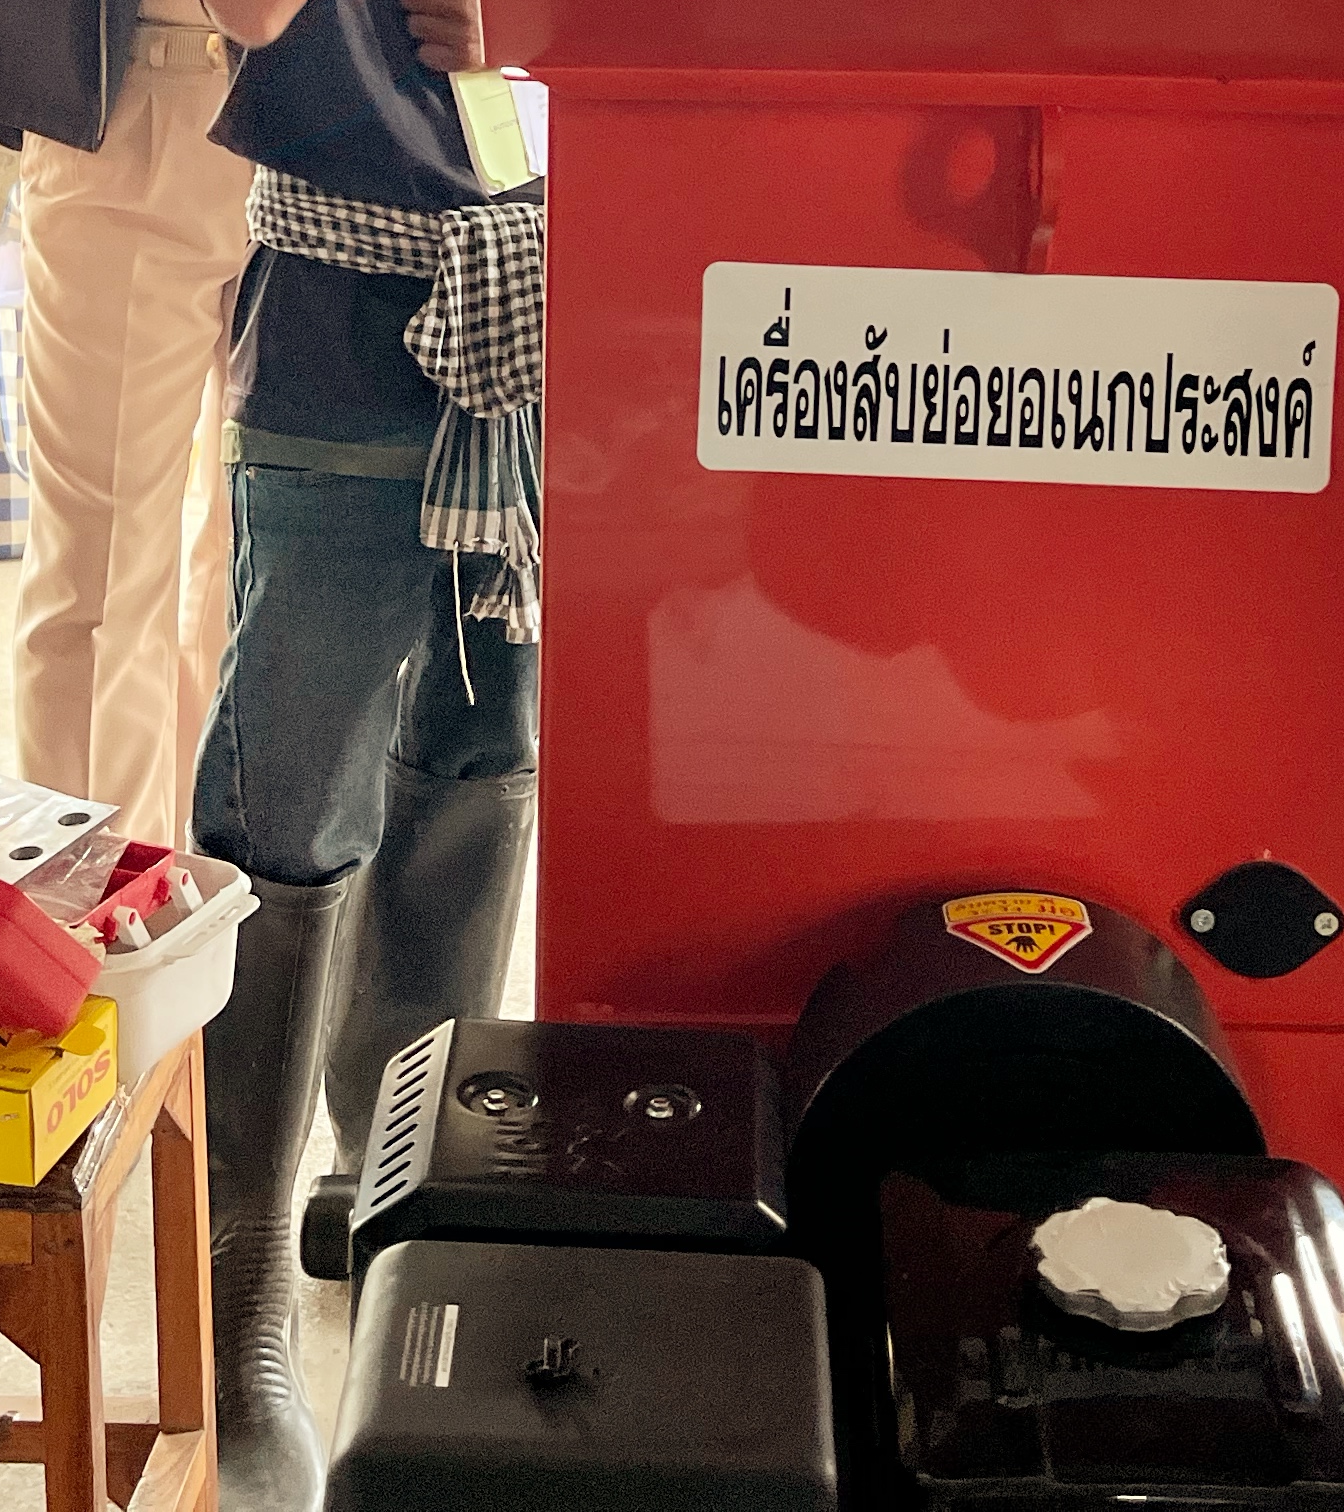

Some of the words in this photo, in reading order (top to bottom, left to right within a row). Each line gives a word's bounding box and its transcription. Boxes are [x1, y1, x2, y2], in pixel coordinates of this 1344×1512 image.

[717, 287, 1316, 459] เครื่องสับย่อยอเนกประสงค์
[987, 922, 1056, 936] STOP!
[46, 1049, 111, 1135] SOLO
